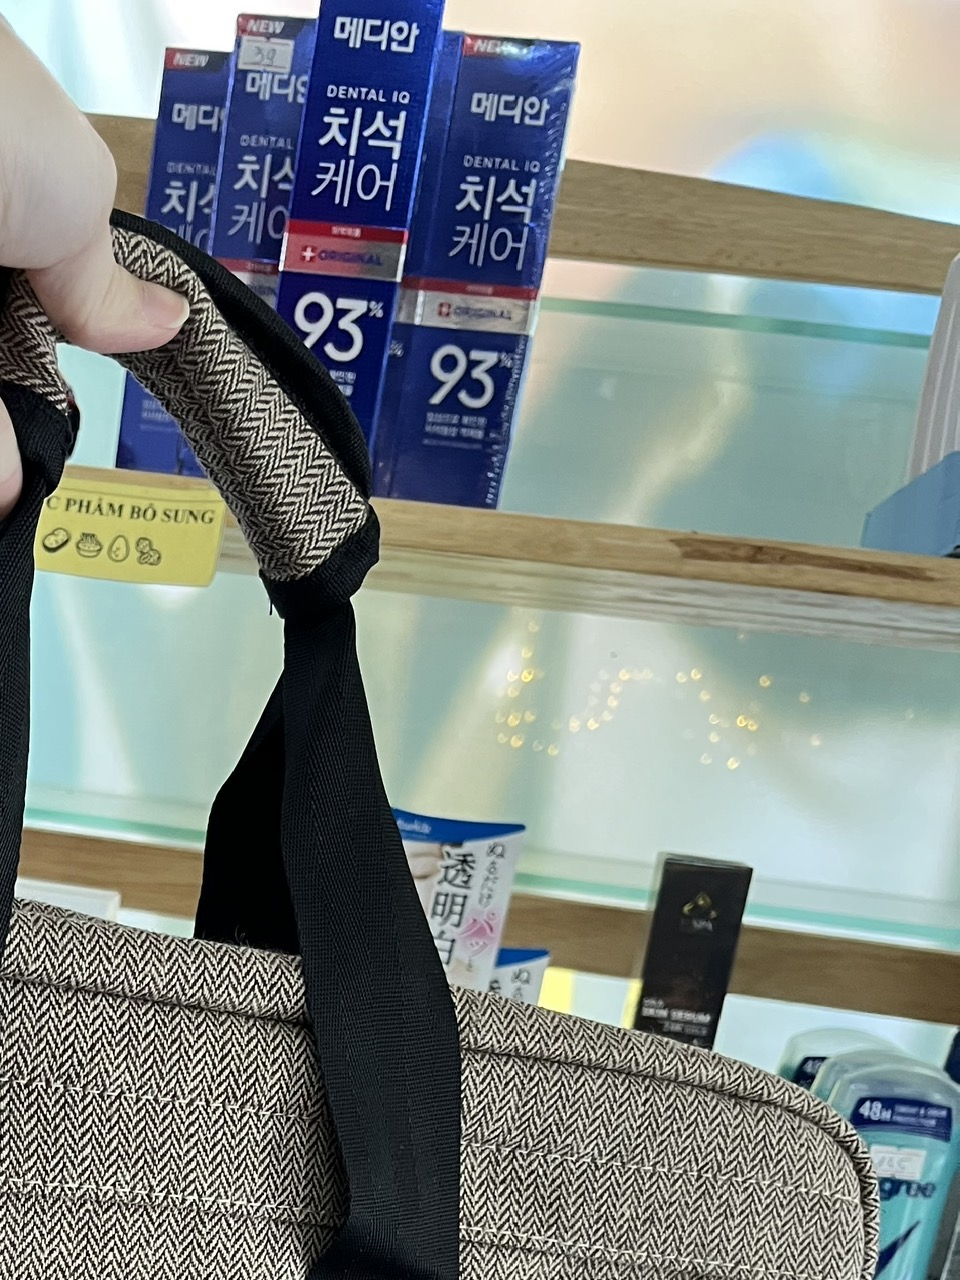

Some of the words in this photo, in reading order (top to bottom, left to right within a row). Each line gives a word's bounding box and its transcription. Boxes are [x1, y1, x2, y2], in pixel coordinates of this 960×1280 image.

[246, 19, 285, 34] NEW
[333, 16, 420, 54] 메디안
[172, 52, 210, 67] NEW
[326, 84, 387, 102] DENTAL
[392, 90, 411, 105] IQ
[470, 91, 551, 127] 메디안
[171, 103, 225, 133] 메디
[239, 134, 295, 150] DENTAL
[318, 106, 407, 161] 치석
[463, 154, 520, 172] DENTAL
[524, 160, 541, 173] IQ
[310, 158, 399, 212] 케어
[455, 175, 538, 224] 치석
[448, 222, 530, 272] 케어
[160, 507, 217, 526] SUNG
